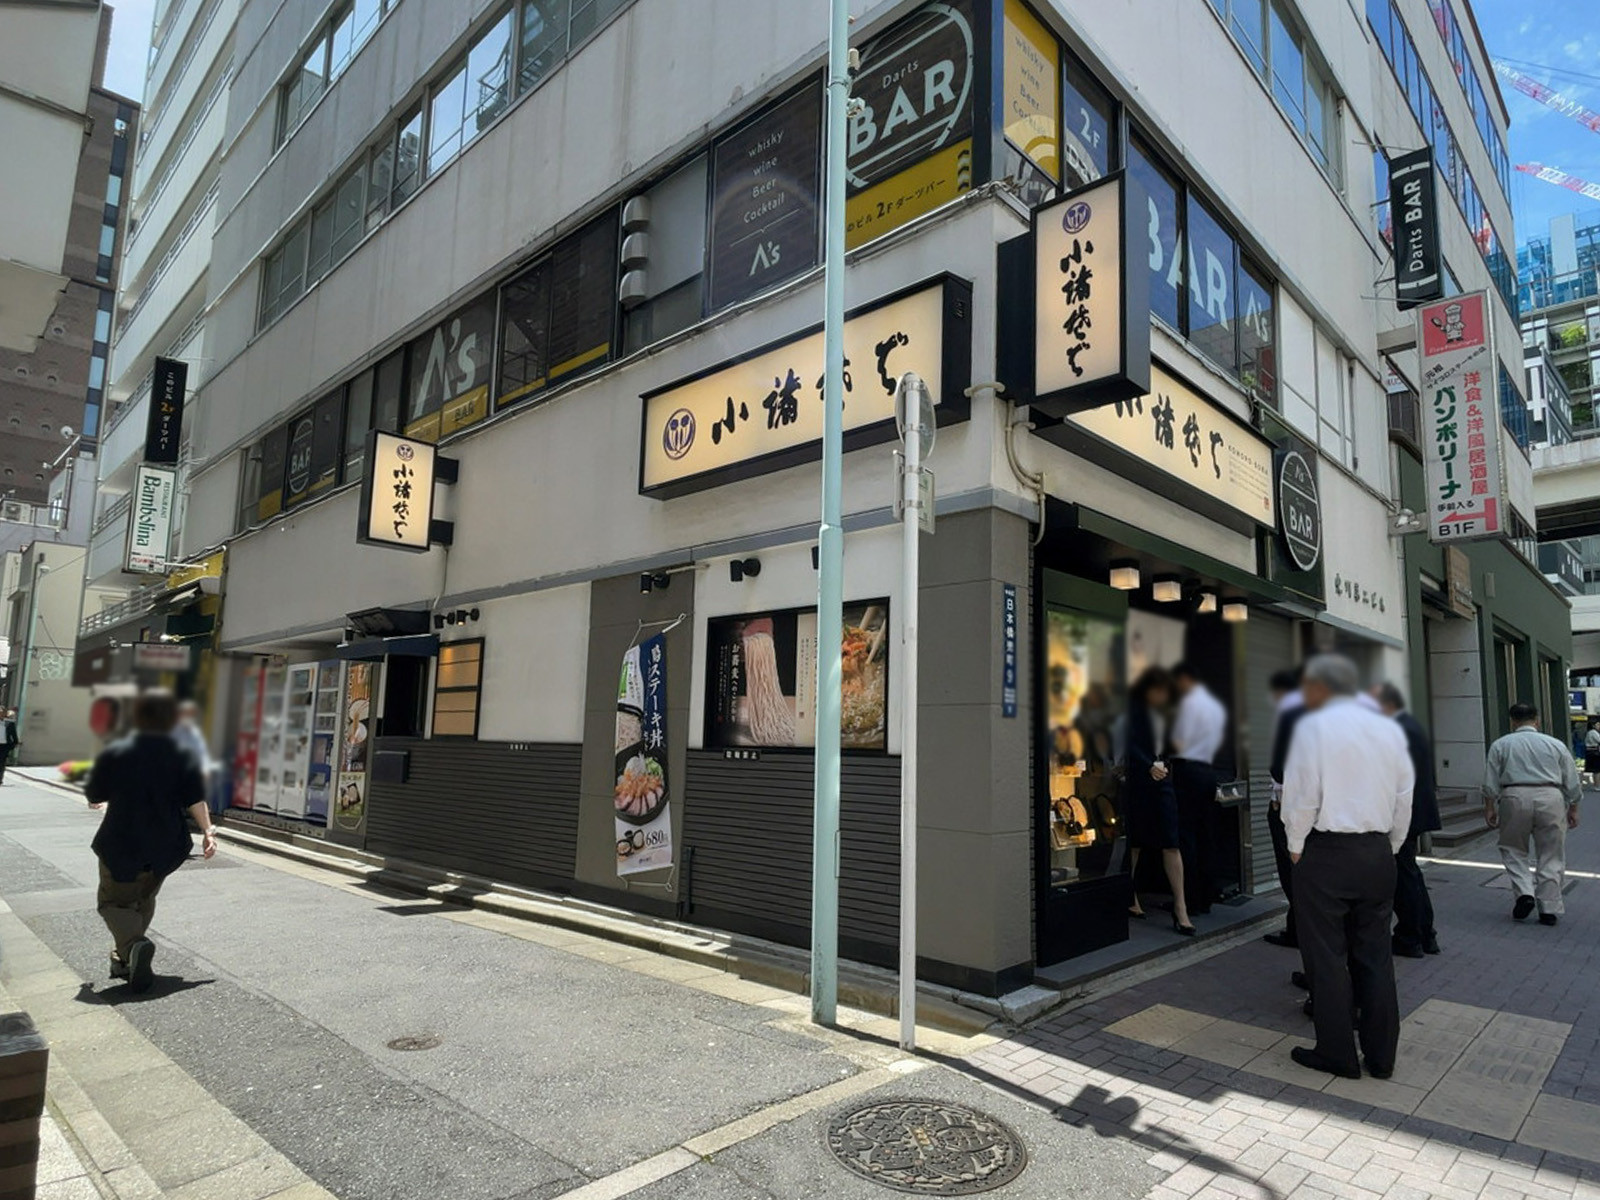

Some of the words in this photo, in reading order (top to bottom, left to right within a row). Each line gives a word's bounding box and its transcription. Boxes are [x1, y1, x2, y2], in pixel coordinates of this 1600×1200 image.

[1015, 36, 1045, 72] whisky
[882, 60, 918, 88] Darts
[1020, 66, 1040, 89] wine
[848, 59, 955, 158] BAR
[1019, 84, 1040, 110] Beer
[748, 129, 784, 159] whisky
[1081, 107, 1101, 149] 2F
[752, 157, 778, 176] wine
[752, 178, 776, 198] Beer
[1403, 179, 1423, 223] BAR
[743, 192, 785, 223] Cocktail
[1409, 228, 1424, 272] Darts
[1463, 371, 1488, 496] 洋食&洋風居酒屋
[136, 475, 162, 547] Bambolina
[160, 481, 171, 519] RESTAURANT
[1289, 504, 1313, 541] BAR
[1438, 521, 1475, 536] B1F
[646, 830, 663, 846] 680
